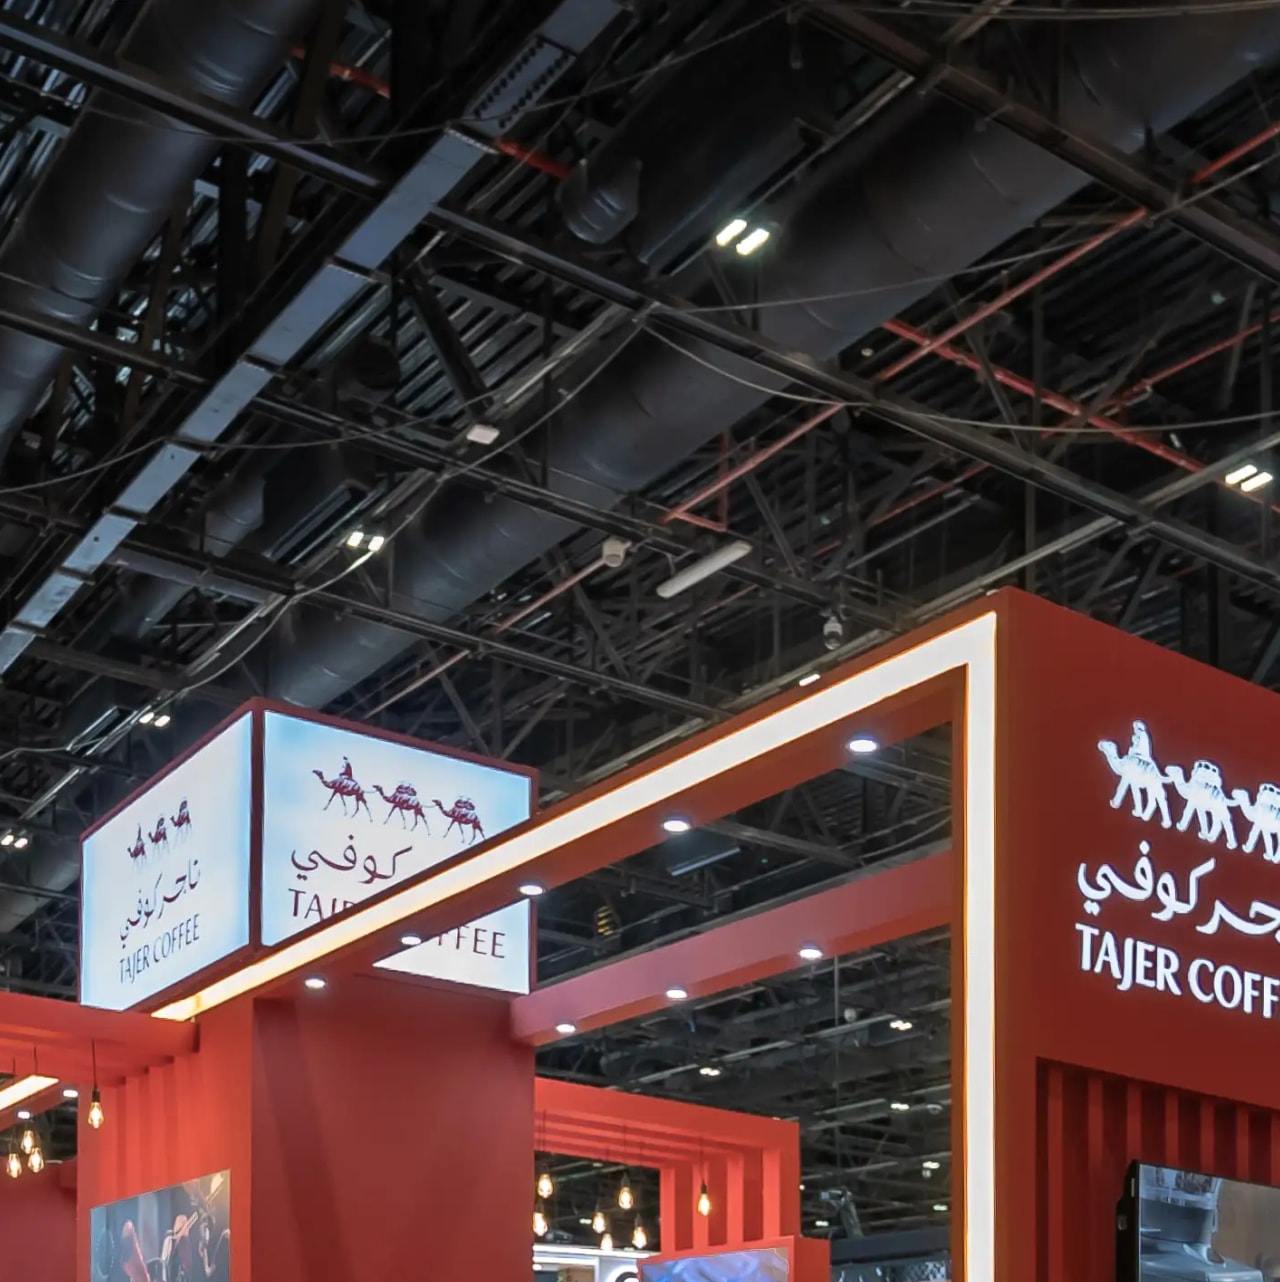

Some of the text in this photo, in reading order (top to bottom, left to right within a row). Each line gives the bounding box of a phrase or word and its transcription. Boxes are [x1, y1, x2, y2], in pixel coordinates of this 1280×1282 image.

[292, 834, 413, 884] كوفي
[1077, 839, 1216, 921] كوفي
[120, 872, 163, 949] كوفي
[120, 913, 200, 984] TAJER COFFEE
[1075, 922, 1182, 996] TAJER
